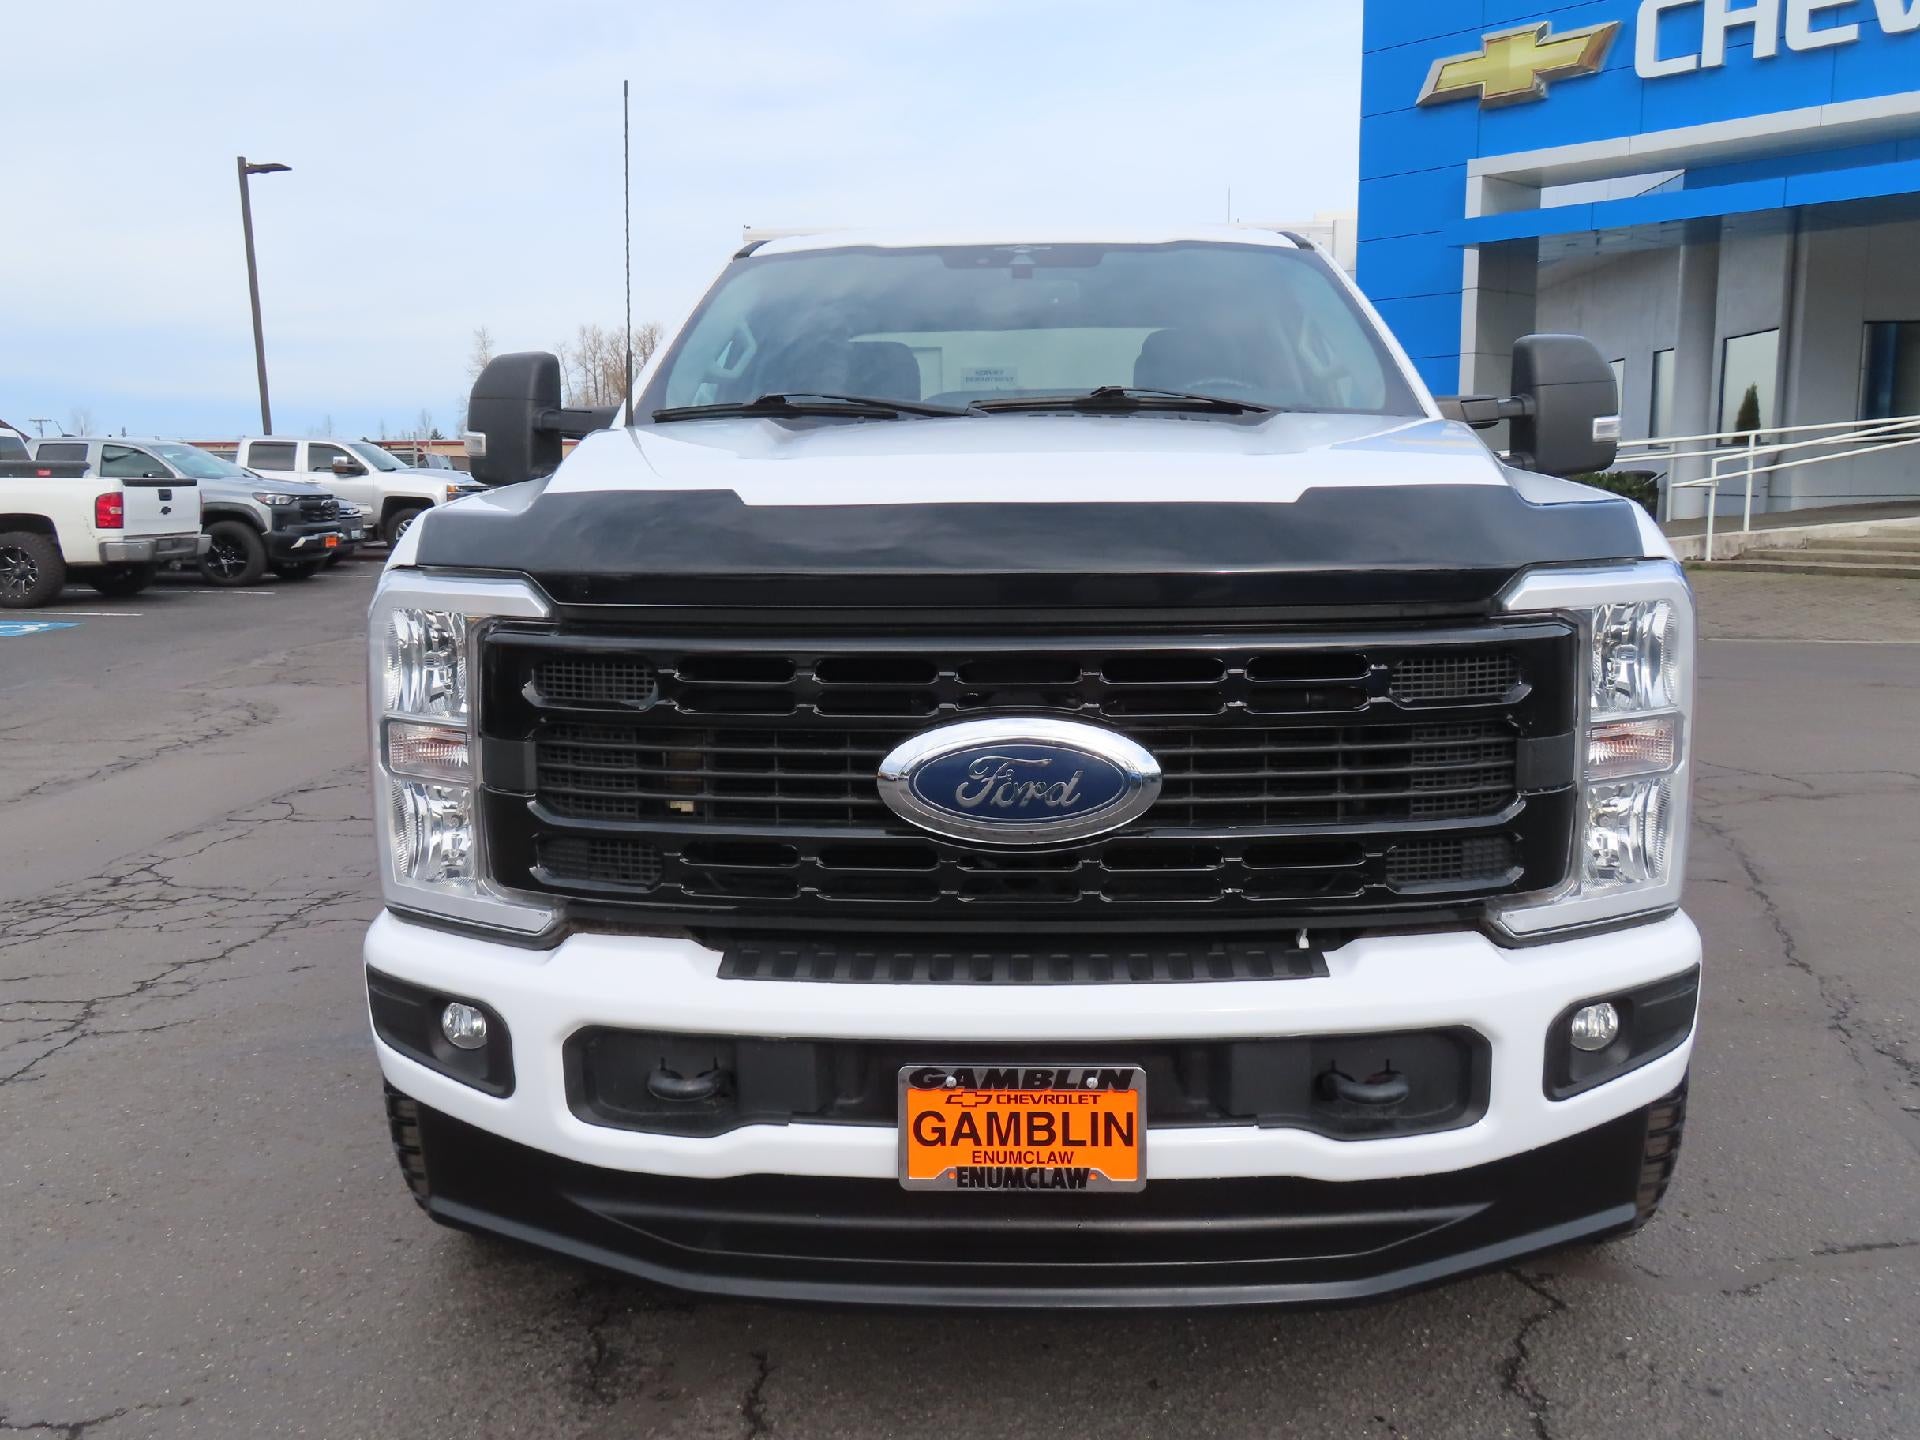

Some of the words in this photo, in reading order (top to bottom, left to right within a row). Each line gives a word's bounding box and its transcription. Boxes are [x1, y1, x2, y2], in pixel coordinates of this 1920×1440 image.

[955, 755, 1081, 807] Ford
[909, 1068, 1134, 1091] GAMBLIN
[996, 1094, 1101, 1105] CHEVROLET
[912, 1110, 1134, 1147] GAMBLIN
[972, 1150, 1074, 1165] ENUMCLAW
[956, 1167, 1090, 1189] ENUMCLAW
